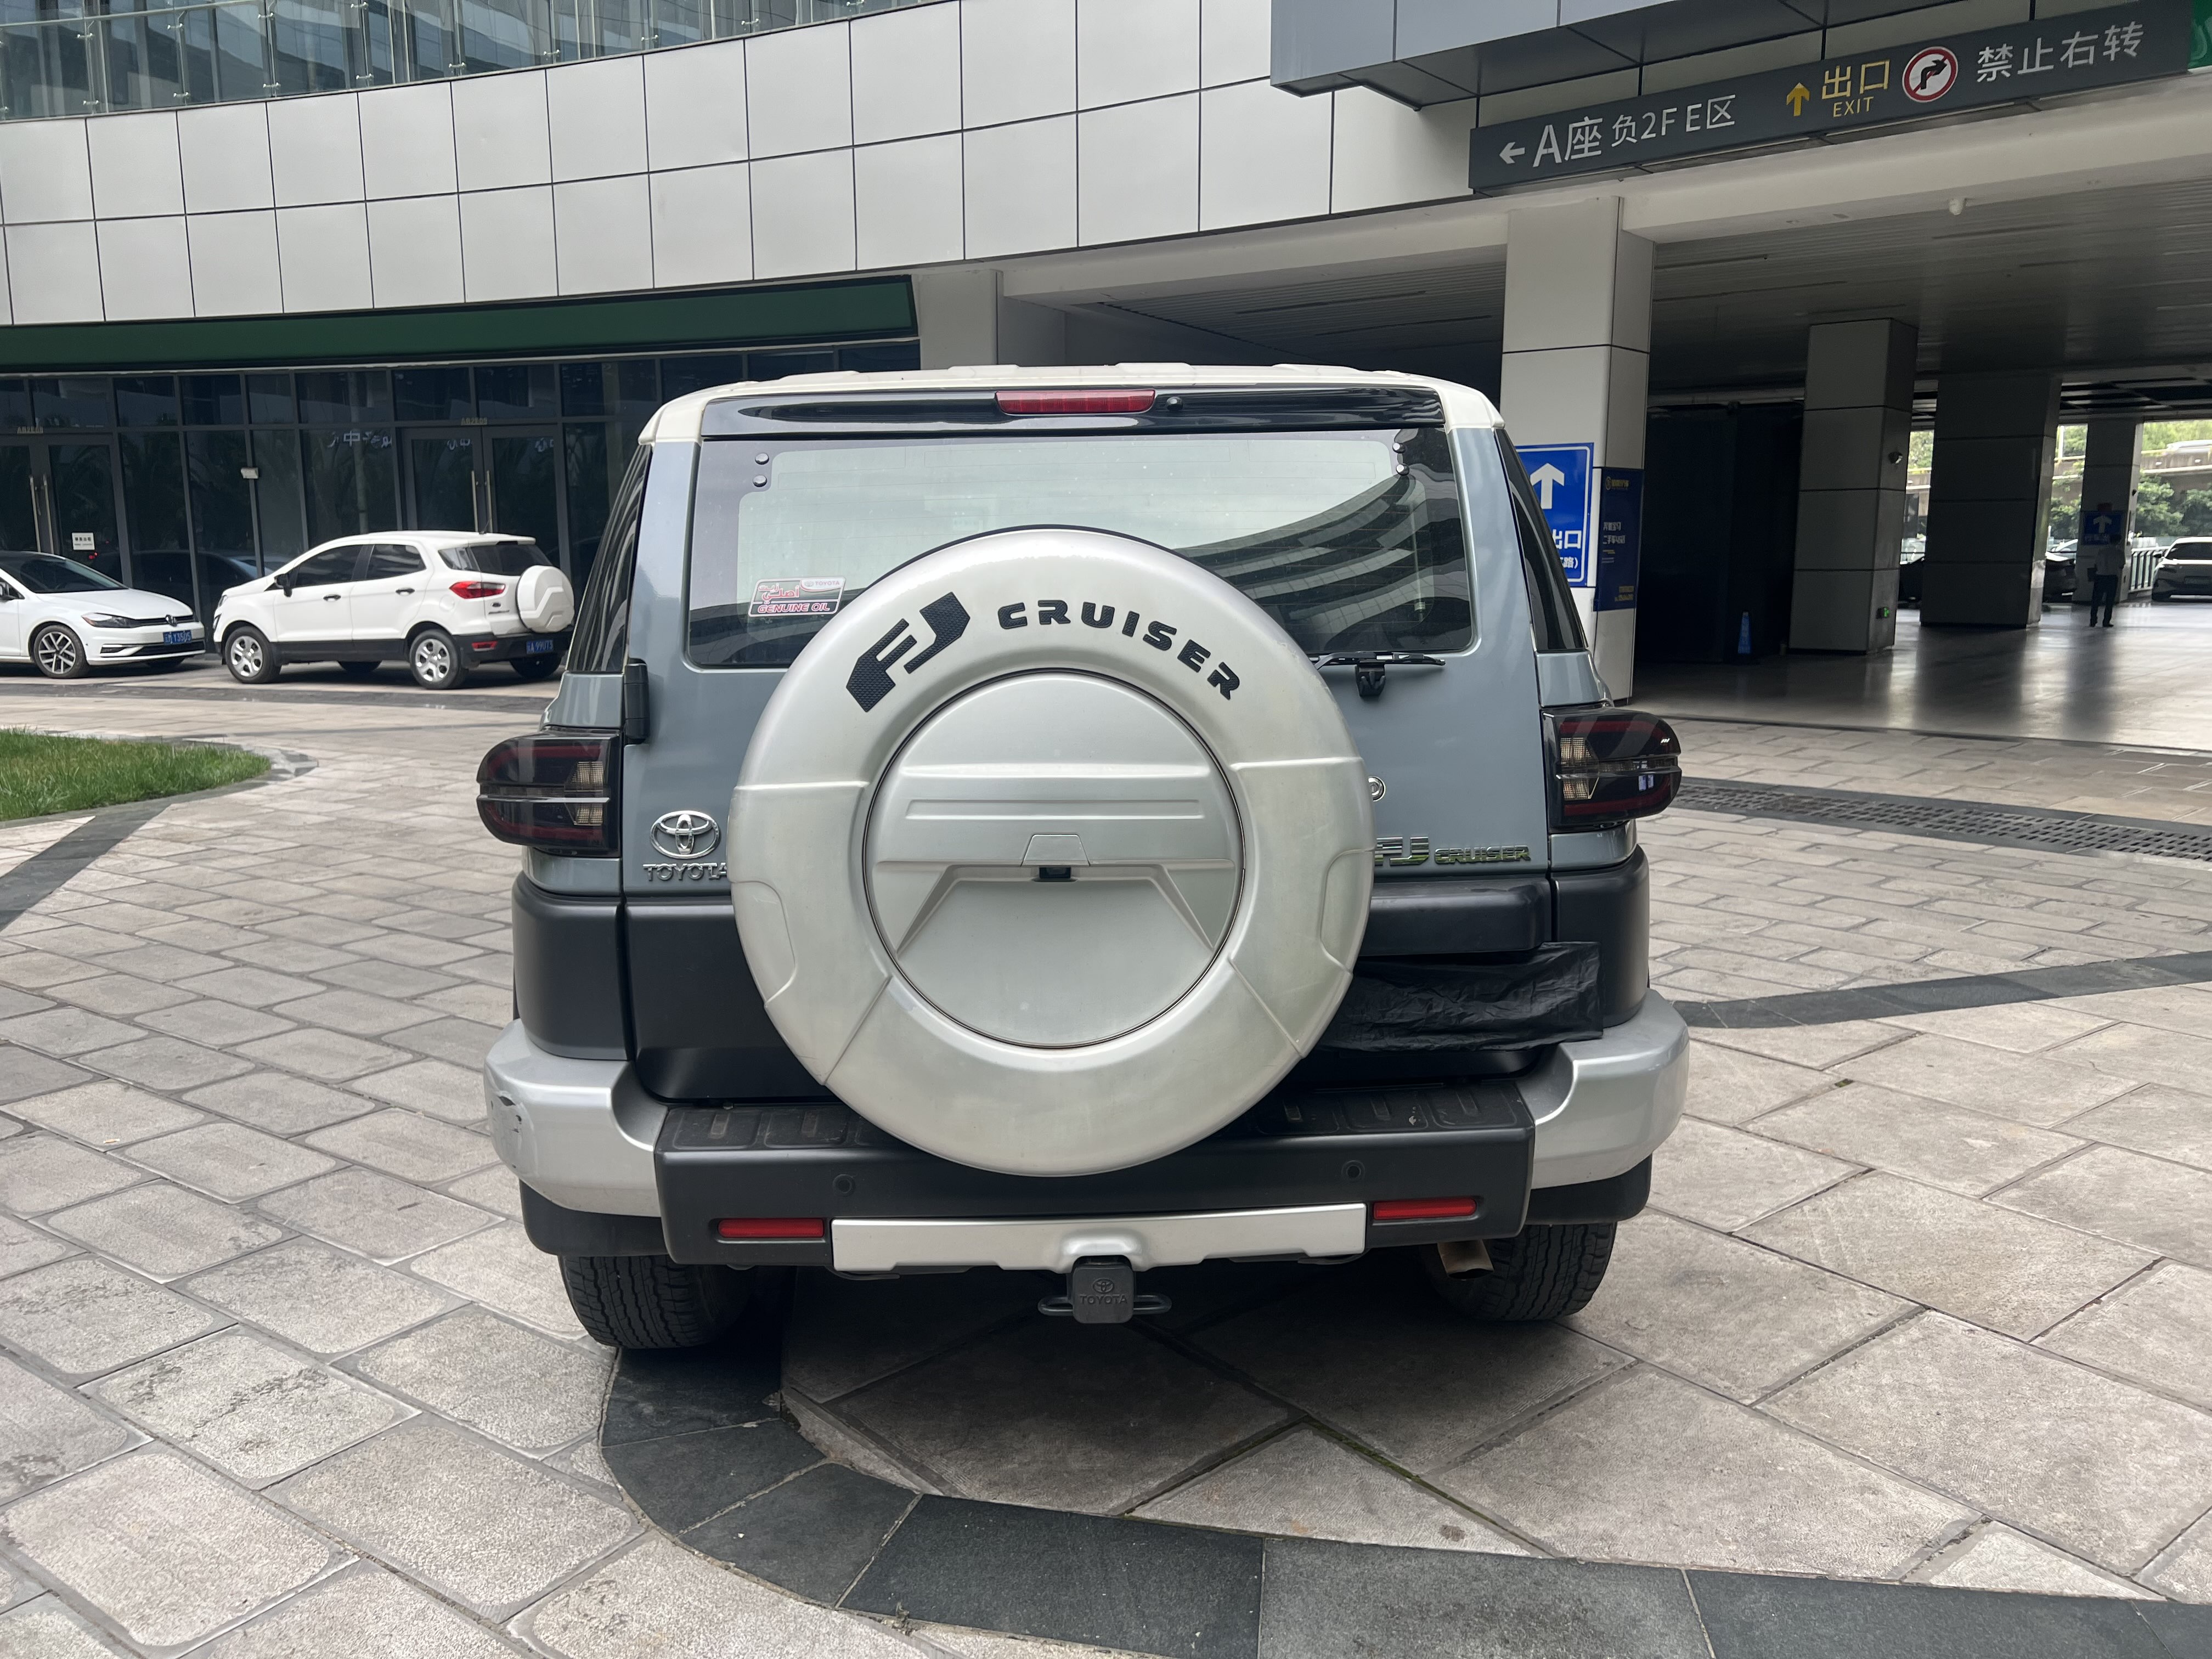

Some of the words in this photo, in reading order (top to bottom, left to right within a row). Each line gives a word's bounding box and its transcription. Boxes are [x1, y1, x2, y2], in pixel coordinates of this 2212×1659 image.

[1977, 21, 2145, 83] 禁止右转
[1821, 58, 1891, 100] 出口
[1832, 97, 1874, 118] EXIT
[1533, 116, 1603, 167] A座
[757, 603, 810, 613] GENUINE
[811, 602, 830, 612] OIL
[846, 591, 970, 712] FJ
[997, 599, 1240, 700] CRUISER
[1374, 837, 1429, 866] FJ
[1435, 845, 1531, 865] CRUISER
[642, 862, 727, 881] TOYOTA
[1080, 1294, 1128, 1305] TOYOTA
